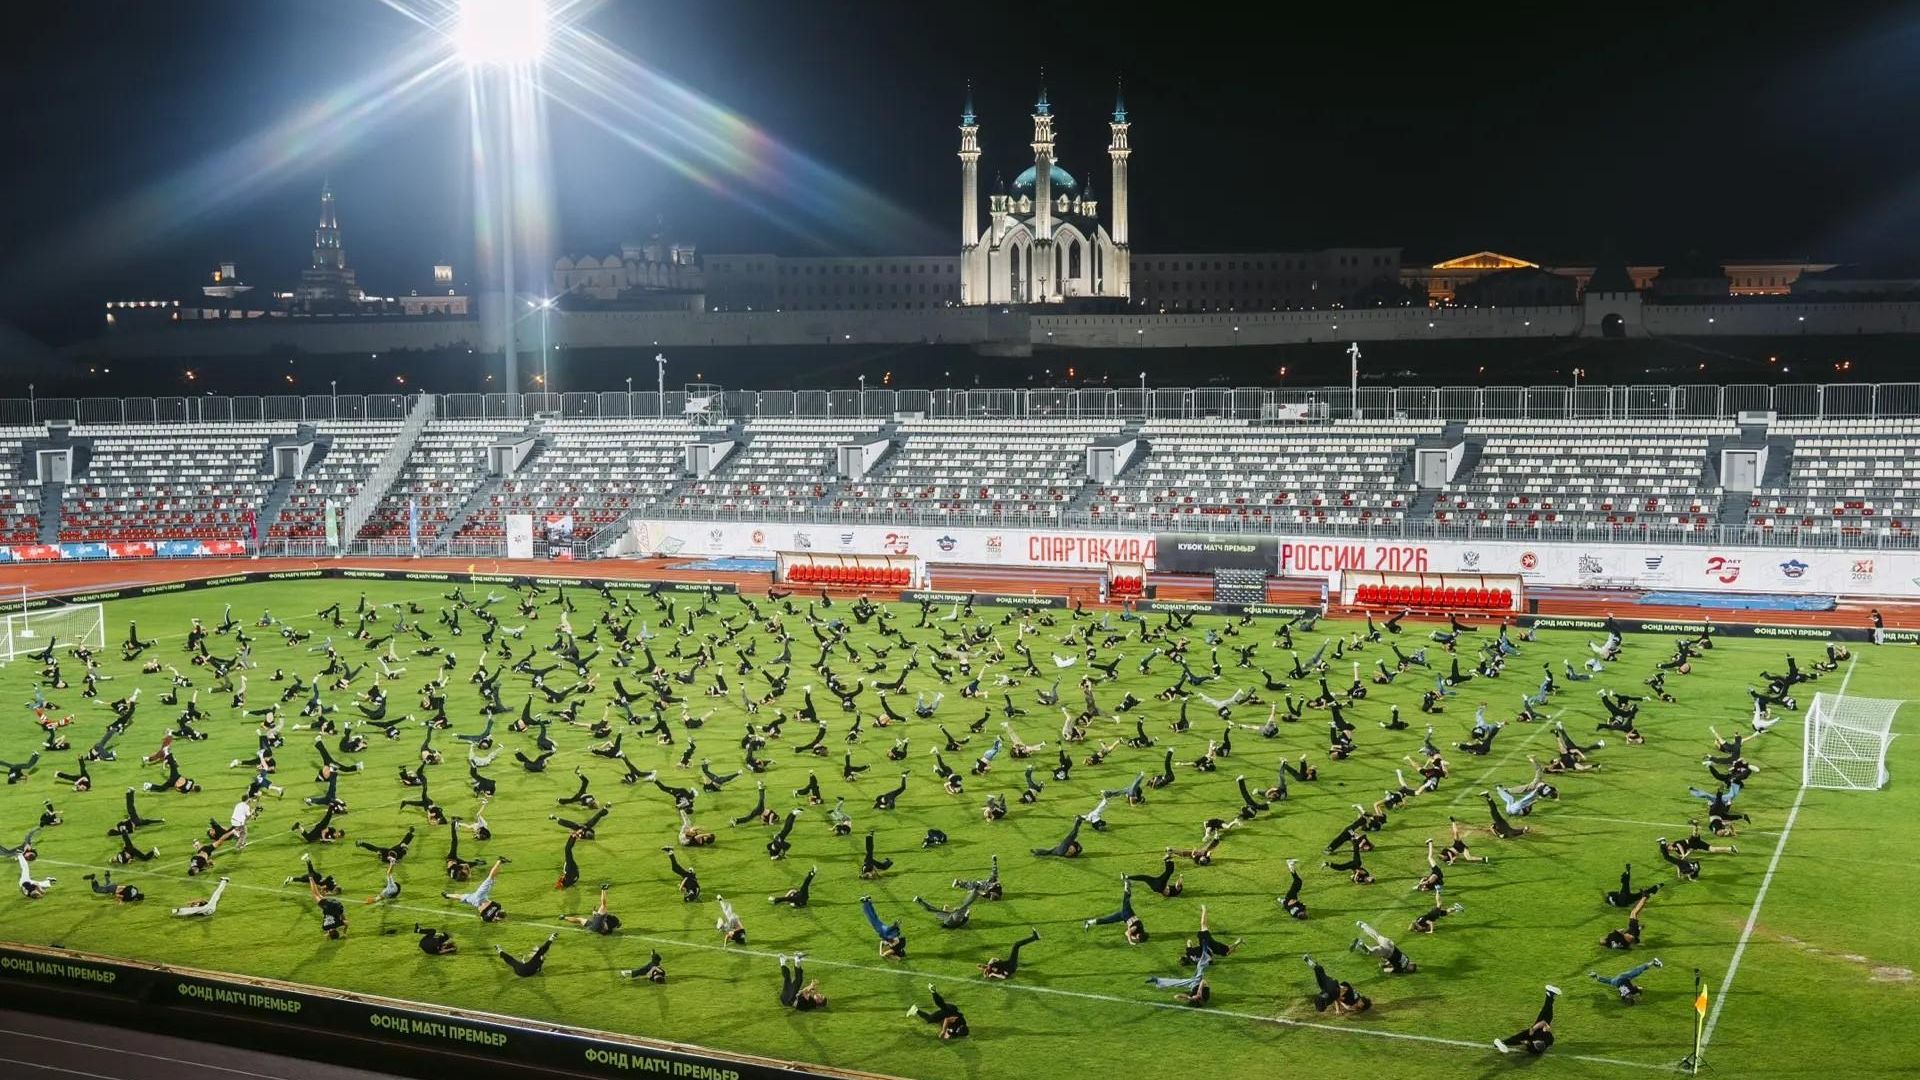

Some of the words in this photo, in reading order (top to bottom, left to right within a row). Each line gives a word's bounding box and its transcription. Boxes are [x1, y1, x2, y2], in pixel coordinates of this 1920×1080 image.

[1178, 543, 1202, 551] КУБОК
[1203, 544, 1222, 552] МАТЧ
[1224, 545, 1256, 553] ПРЕМЬЕР
[1282, 544, 1365, 571] РОССИИ
[1376, 546, 1428, 572] 2026
[0, 957, 34, 974] ФОНД
[36, 962, 65, 976] МАТЧ
[68, 966, 116, 983] ПРЕМЬЕР
[178, 983, 213, 1001] ФОНД
[216, 988, 246, 1005] МАТЧ
[249, 995, 301, 1013] ПРЕМЬЕР
[370, 1013, 409, 1033] ФОНД
[412, 1020, 446, 1037] МАТЧ
[449, 1026, 507, 1046] ПРЕМЬЕР
[584, 1048, 628, 1069] ФОНД
[632, 1055, 670, 1073] МАТЧ
[673, 1062, 739, 1080] ПРЕМЬЕР
